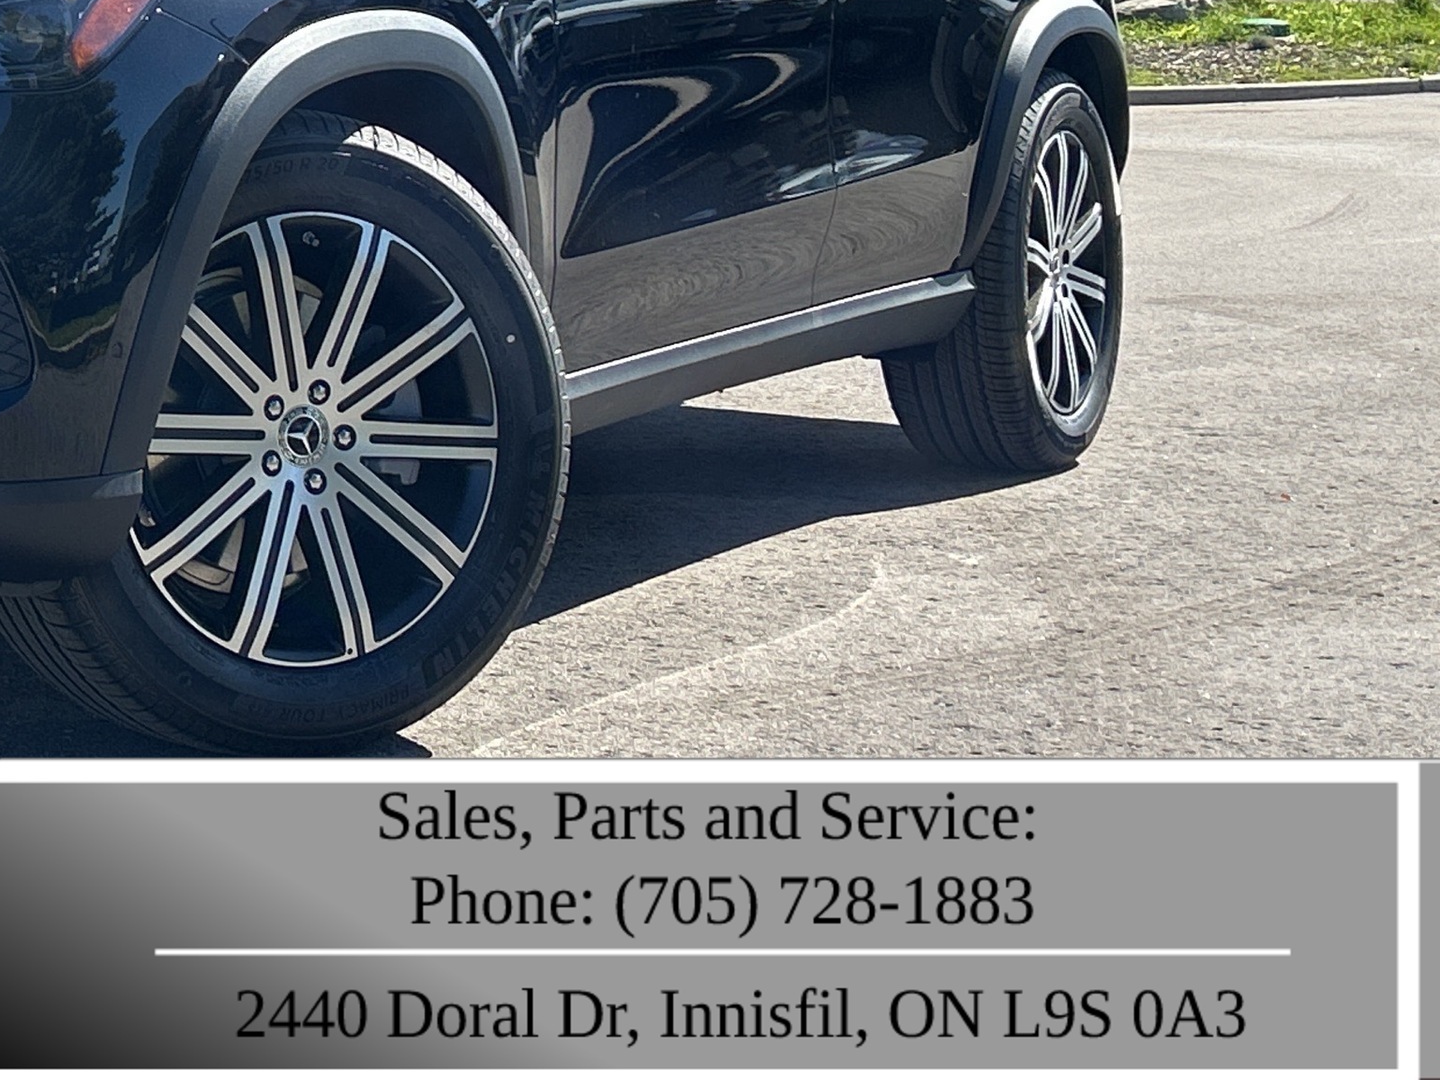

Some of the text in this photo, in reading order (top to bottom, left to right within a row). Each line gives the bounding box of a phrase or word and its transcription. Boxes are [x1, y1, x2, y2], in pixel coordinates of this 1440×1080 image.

[430, 489, 547, 685] MICHELIN
[277, 705, 327, 722] TOUR
[338, 684, 410, 719] PRIMACY
